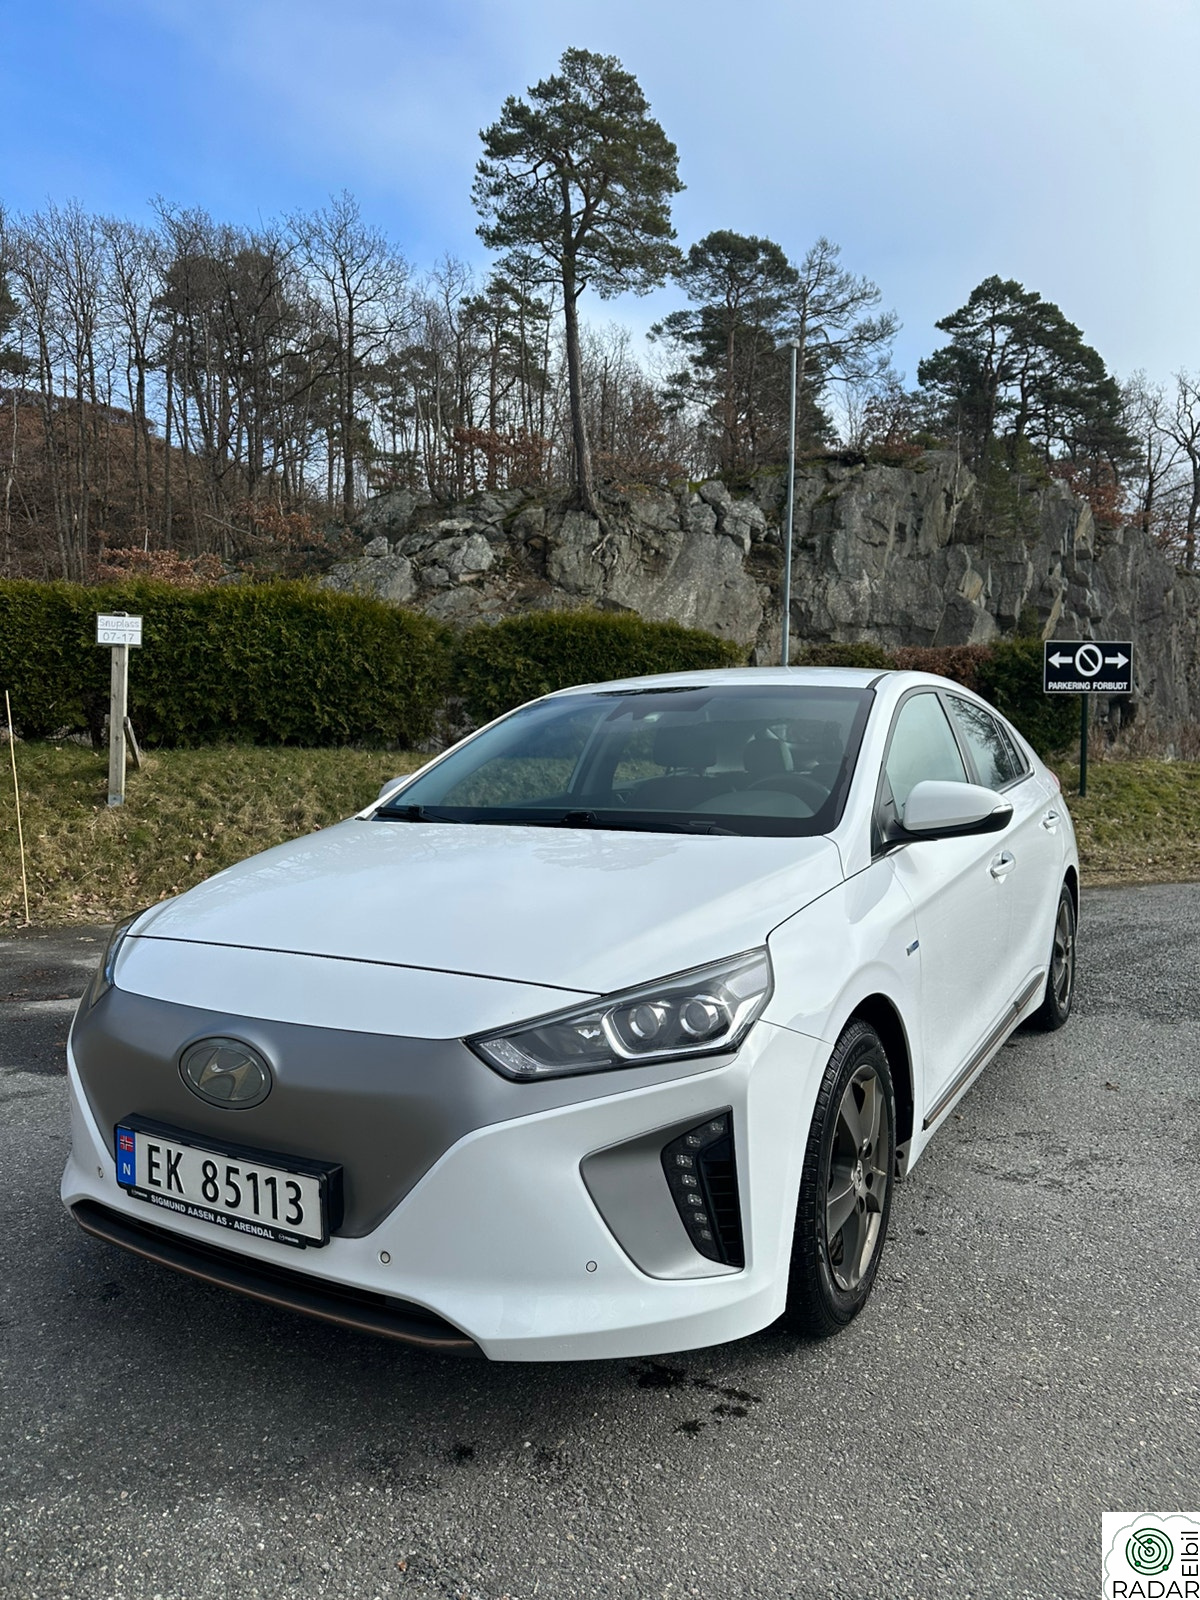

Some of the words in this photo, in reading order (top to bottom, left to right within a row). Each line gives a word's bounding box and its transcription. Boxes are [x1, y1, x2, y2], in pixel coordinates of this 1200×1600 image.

[99, 617, 140, 629] Snuplass
[102, 631, 135, 643] 07-17
[1047, 681, 1091, 690] PARKERING
[1092, 681, 1128, 690] FORBUDT
[122, 1162, 131, 1176] N
[147, 1142, 185, 1194] EK
[201, 1159, 304, 1226] 85113
[150, 1194, 186, 1213] SIGMUND
[187, 1206, 215, 1222] AASEN
[215, 1215, 228, 1226] AS
[233, 1220, 275, 1239] ARENDAL
